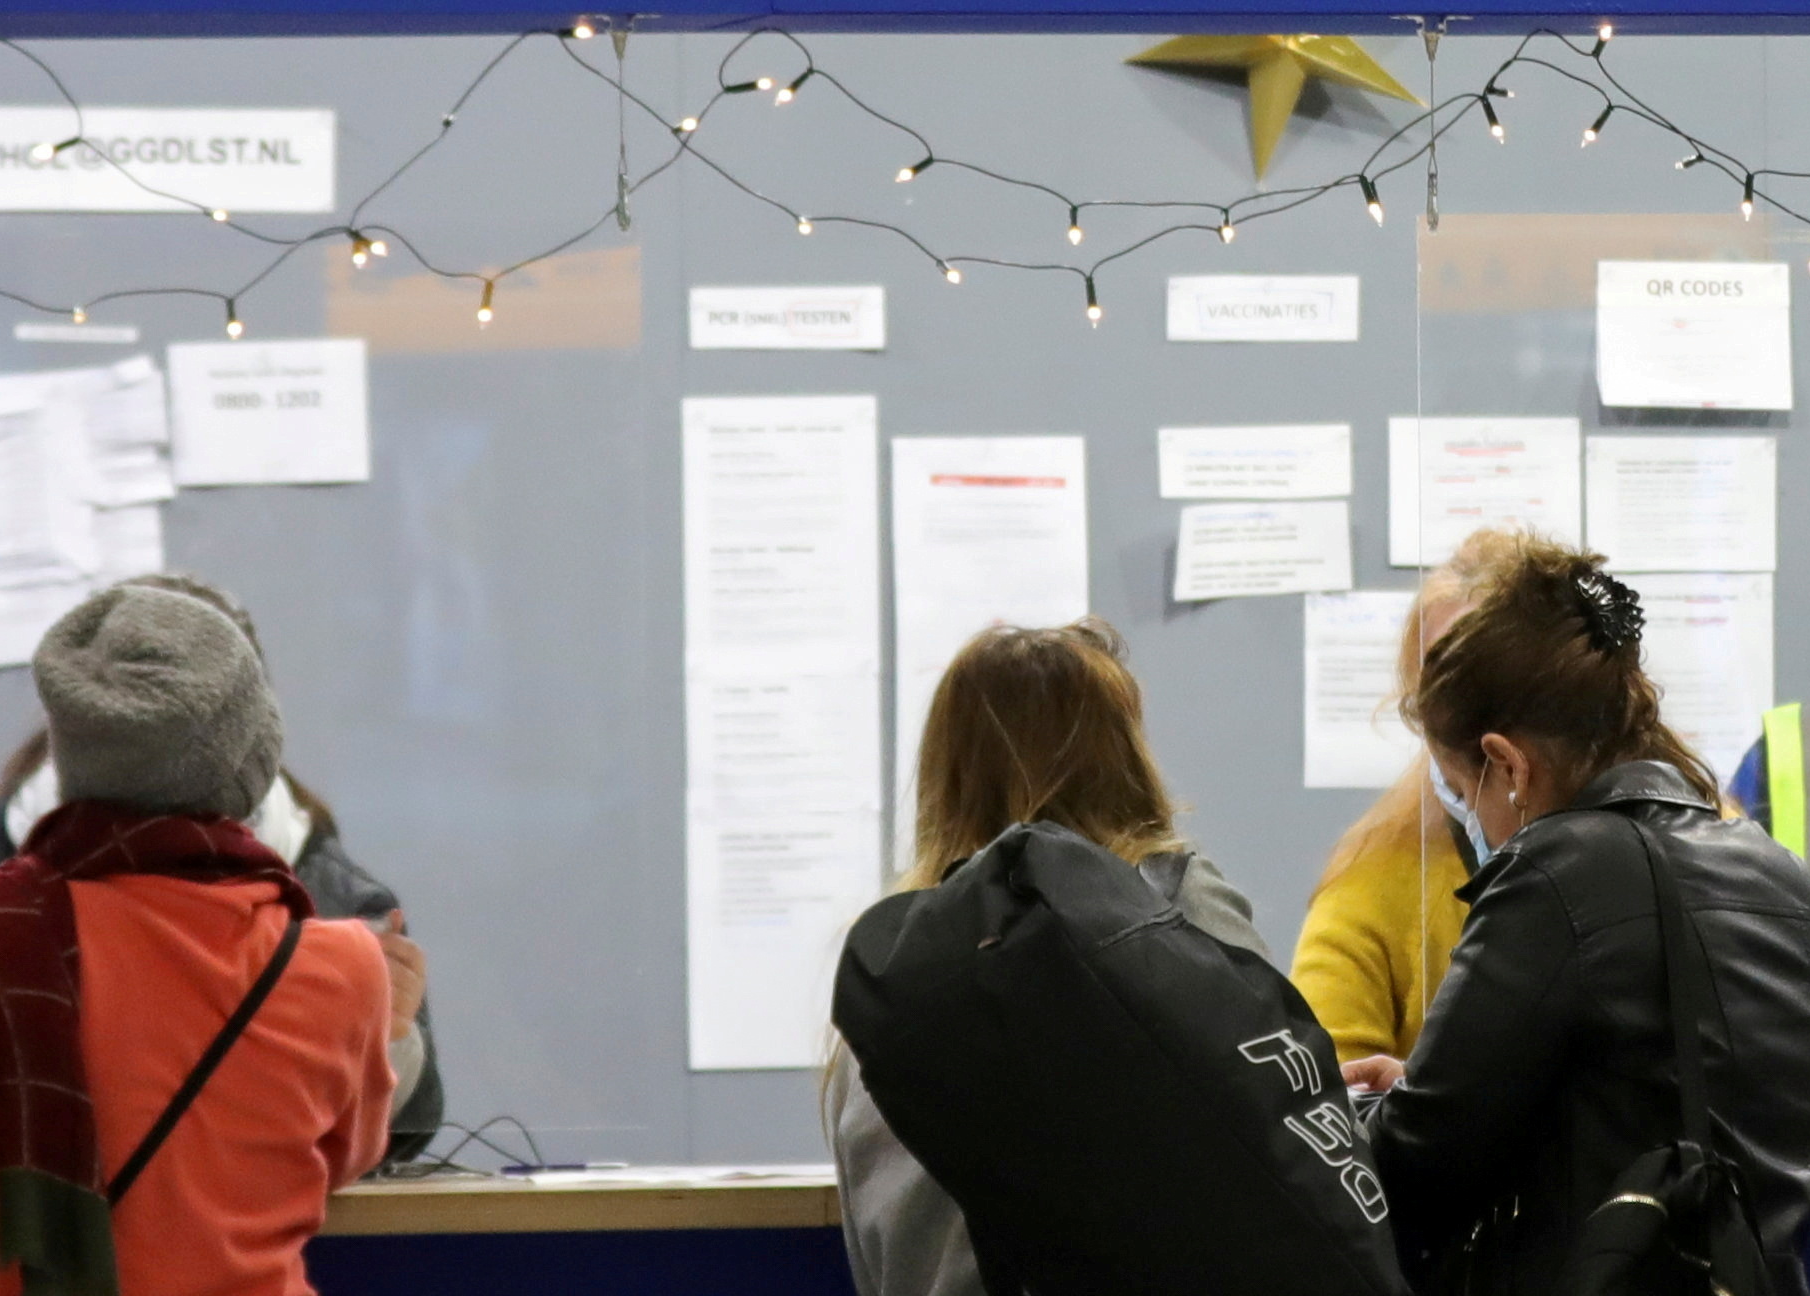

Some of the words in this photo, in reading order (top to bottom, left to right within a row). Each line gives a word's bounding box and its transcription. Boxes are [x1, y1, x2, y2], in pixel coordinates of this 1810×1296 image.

[1646, 279, 1675, 298] QR
[1681, 279, 1744, 297] CODES
[707, 310, 739, 325] PCR
[792, 310, 853, 325] TESTEN
[1207, 303, 1319, 321] VACCINATIES
